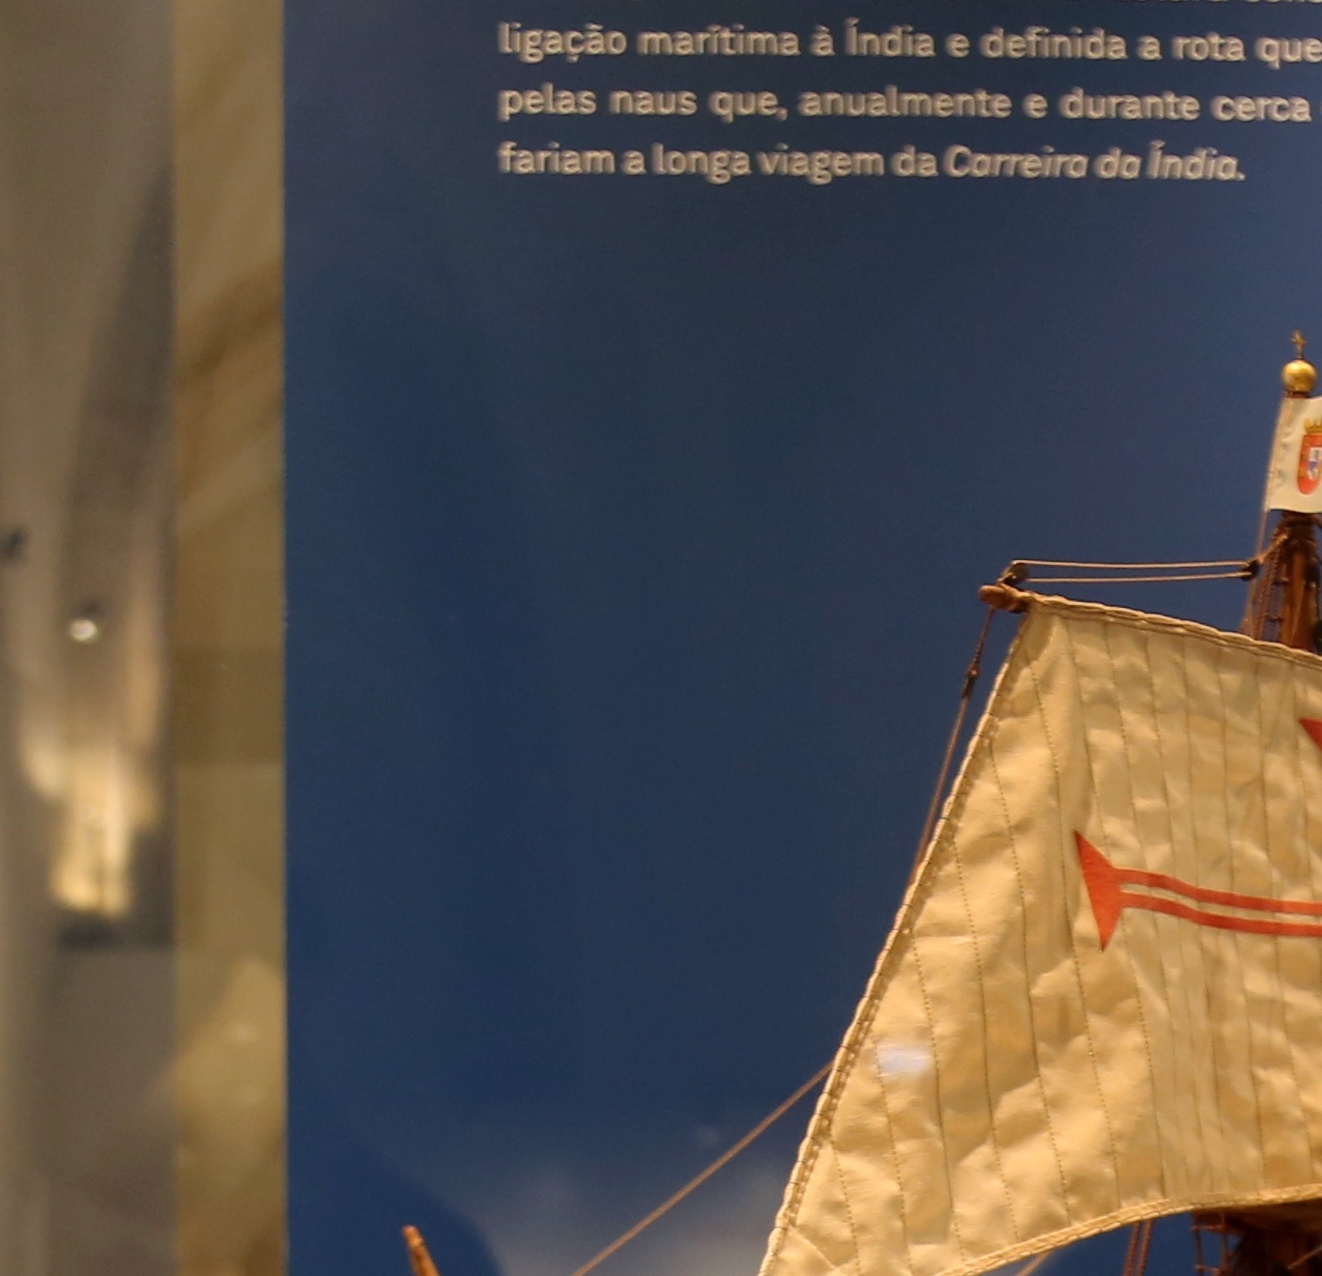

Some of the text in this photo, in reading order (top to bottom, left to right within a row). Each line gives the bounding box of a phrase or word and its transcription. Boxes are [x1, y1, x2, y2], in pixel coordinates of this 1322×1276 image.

[499, 23, 626, 63] ligação
[637, 24, 800, 56] marítima
[810, 25, 835, 56] à
[846, 18, 935, 57] Índia
[946, 34, 969, 57] e
[980, 26, 1128, 59] definida
[1137, 36, 1162, 60] a
[1173, 32, 1246, 61] rota
[499, 83, 596, 121] pelas
[609, 91, 697, 115] naus
[709, 91, 787, 123] que,
[798, 85, 1012, 117] anualmente
[1023, 94, 1047, 118] e
[1059, 87, 1200, 120] durante
[1212, 96, 1312, 122] cerca
[497, 141, 1245, 185] fariam a longa viagem da Carreira da Índia.
